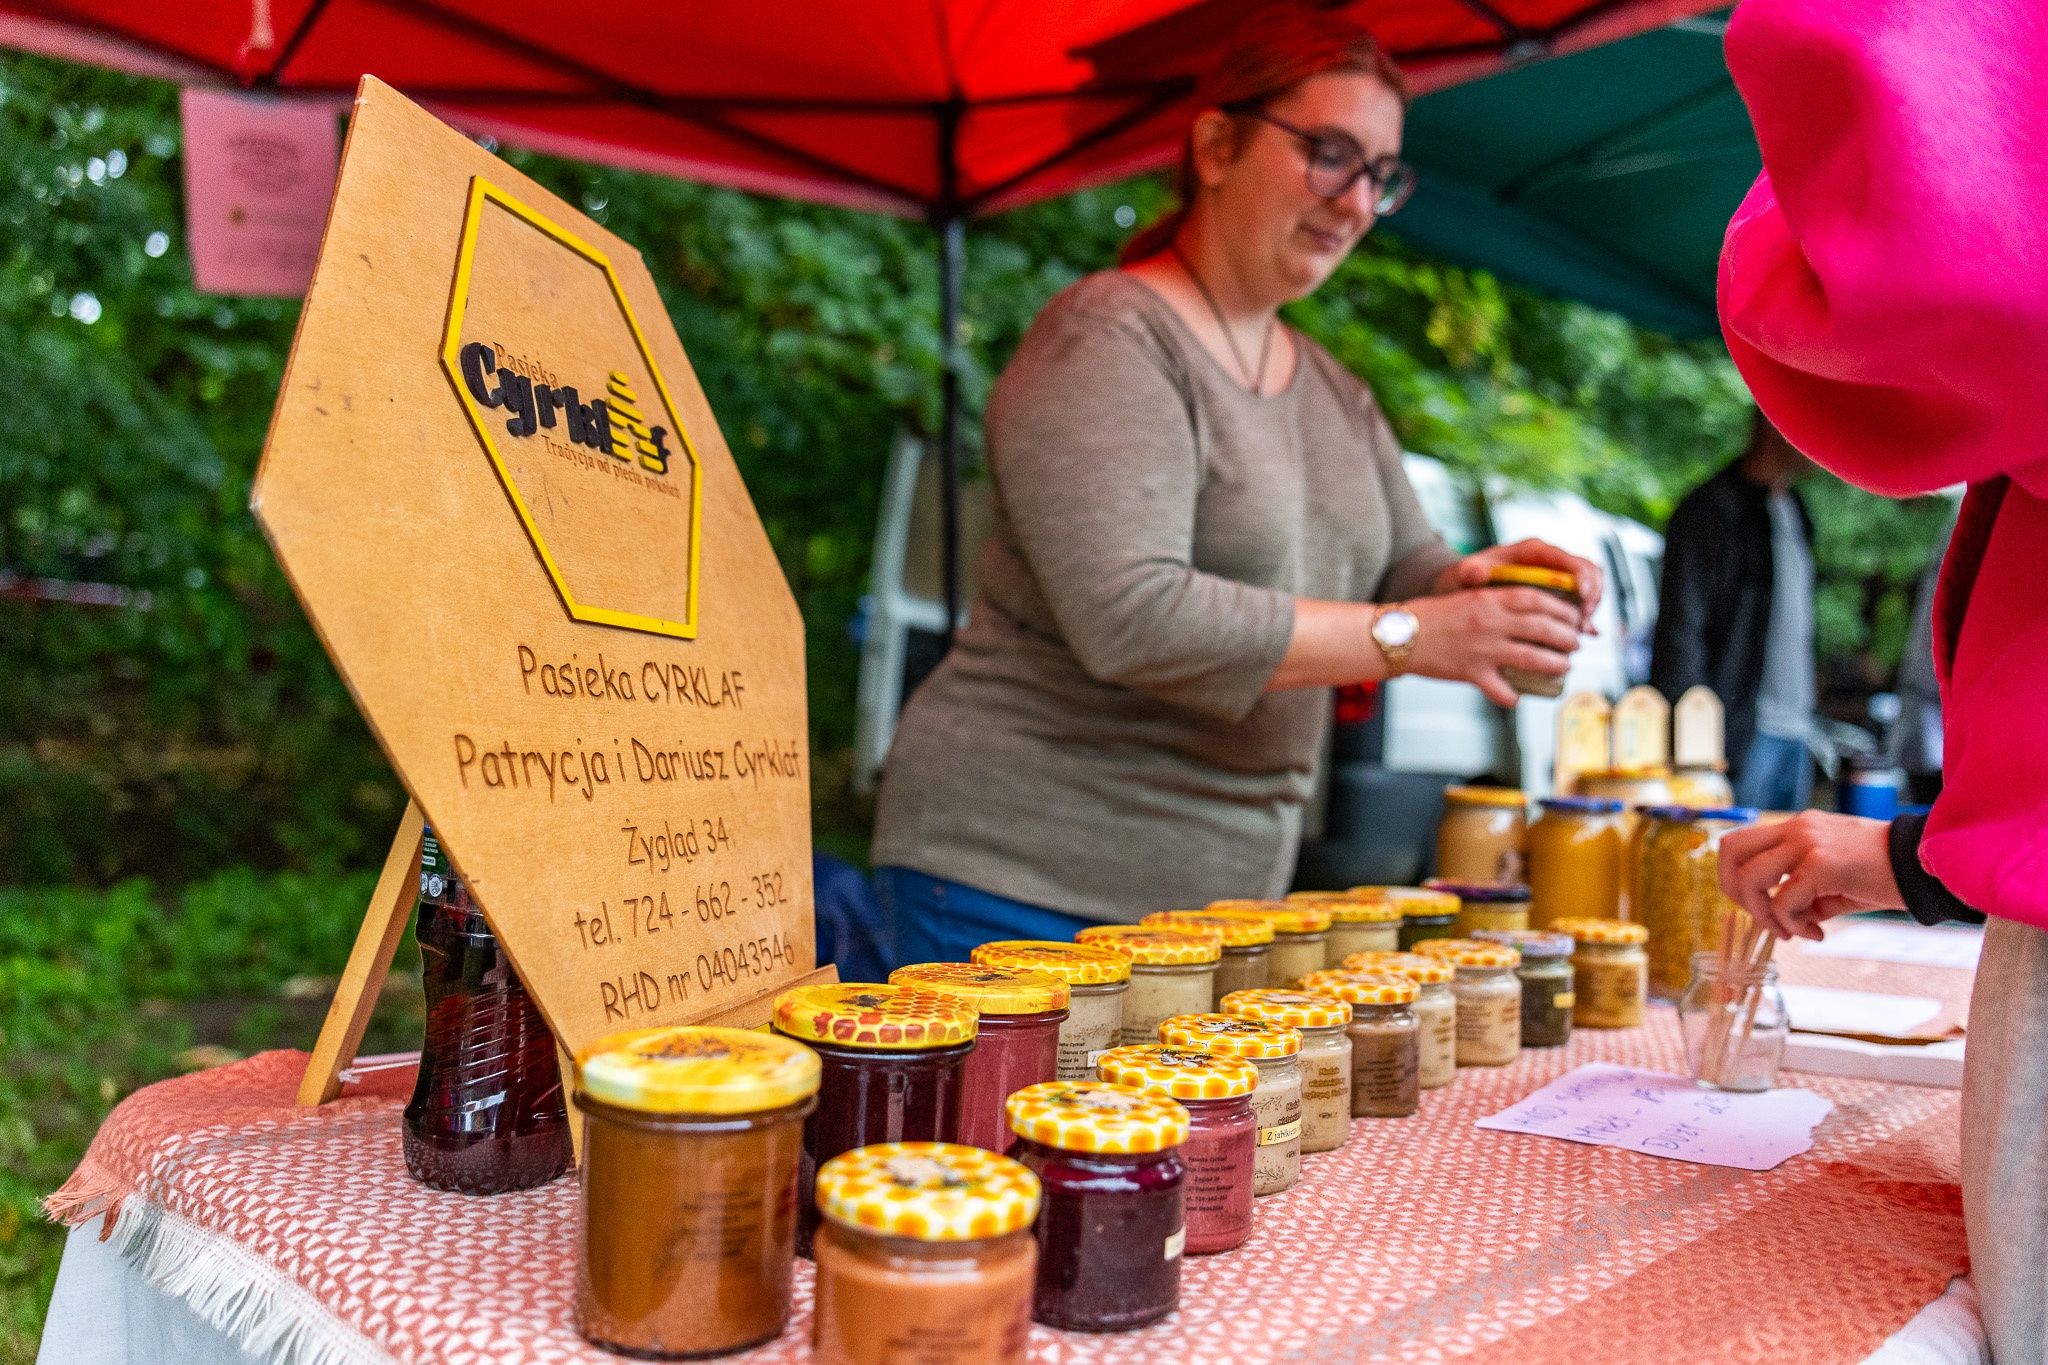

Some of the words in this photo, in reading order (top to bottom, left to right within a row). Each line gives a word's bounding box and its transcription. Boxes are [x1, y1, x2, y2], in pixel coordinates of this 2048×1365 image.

[541, 434, 595, 471] Tradycja
[596, 457, 611, 474] od
[517, 645, 636, 701] Pasieka
[641, 661, 746, 710] CYRKLAF
[454, 734, 611, 802] Patrycja
[614, 738, 627, 783] i
[631, 737, 729, 784] Dariusz
[733, 740, 801, 792] Cyrklaf
[621, 818, 701, 874] Żygląd
[574, 901, 623, 950] tel.
[623, 891, 674, 938] 724
[695, 881, 736, 922] 662
[751, 871, 788, 909] 352
[600, 971, 661, 1023] RHD
[667, 970, 691, 1005] nr
[696, 931, 795, 993] 04043546
